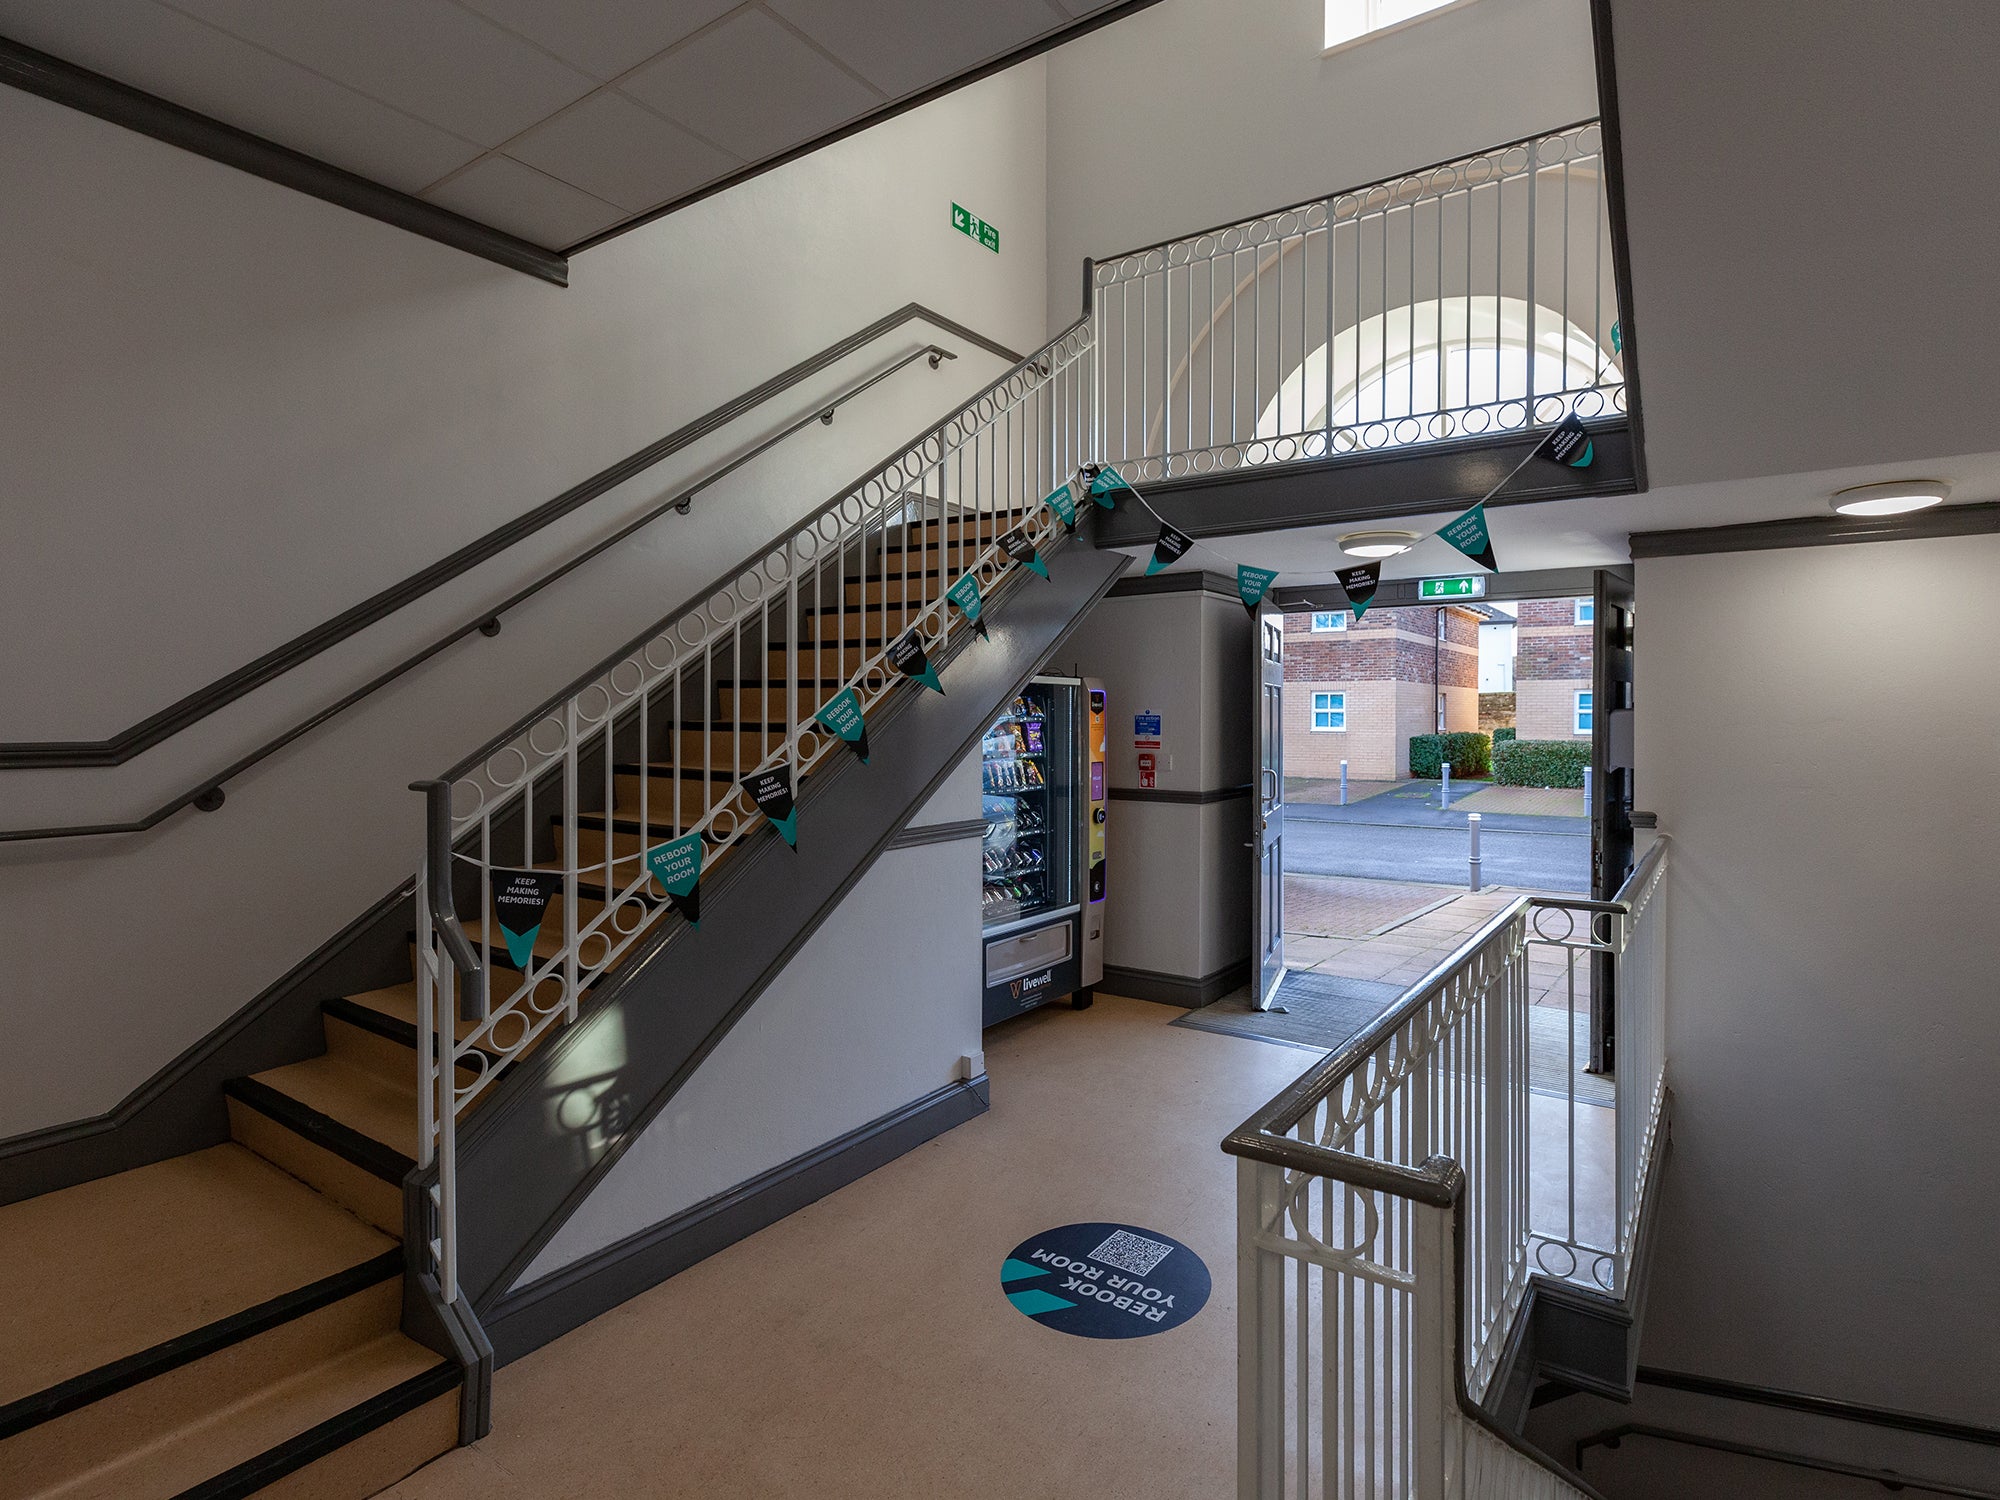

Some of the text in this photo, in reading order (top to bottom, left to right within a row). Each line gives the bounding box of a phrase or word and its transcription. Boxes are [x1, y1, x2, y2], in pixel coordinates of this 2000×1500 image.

[984, 225, 996, 239] Fire
[1552, 431, 1565, 445] KEEP
[1554, 432, 1575, 452] MAKING
[1555, 431, 1583, 460] MEMORIES!
[1447, 514, 1478, 537] REBOOK
[1456, 524, 1478, 540] YOUR
[1460, 531, 1484, 549] ROOM
[1242, 571, 1268, 580] REBOOK
[1244, 579, 1261, 587] YOUR
[1349, 575, 1370, 583] MAKING
[955, 581, 972, 599] REBOOK
[1242, 587, 1260, 595] ROOM
[1346, 580, 1375, 590] MEMORIES!
[963, 590, 974, 603] YOUR
[966, 597, 978, 611] ROOM
[826, 697, 851, 720] REBOOK
[836, 708, 853, 724] YOUR
[841, 715, 859, 734] ROOM
[758, 782, 781, 794] MAKING
[760, 776, 774, 785] KEEP
[757, 787, 788, 803] MEMORIES!
[653, 843, 694, 865] REBOOK
[664, 857, 692, 872] YOUR
[515, 877, 537, 885] KEEP
[667, 867, 695, 884] ROOM
[506, 886, 539, 896] MAKING
[497, 895, 544, 905] MEMORIES!
[1023, 969, 1052, 991] livewell
[1031, 1248, 1175, 1308] YOUR ROOM
[1060, 1276, 1167, 1322] REBOOK
